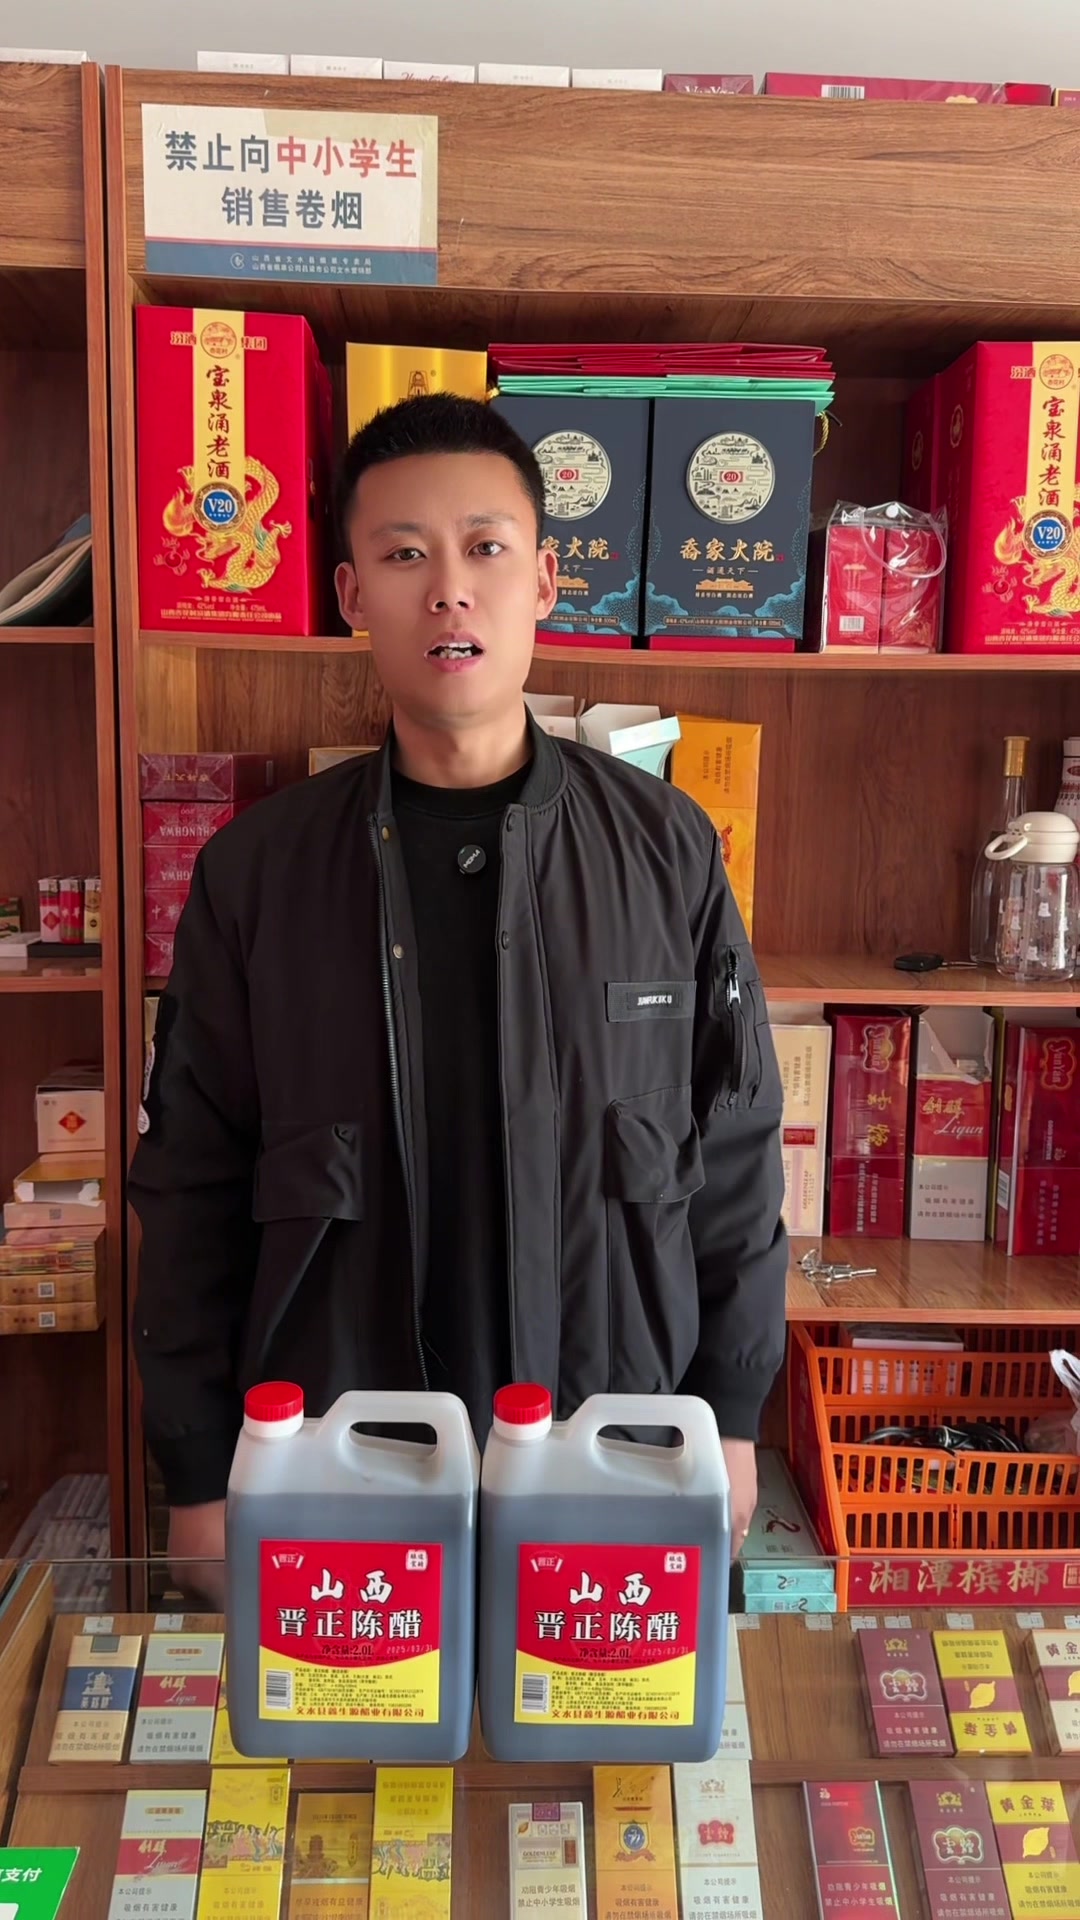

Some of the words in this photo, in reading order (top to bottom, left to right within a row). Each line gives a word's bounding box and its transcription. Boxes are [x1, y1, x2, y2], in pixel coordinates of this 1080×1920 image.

[165, 131, 417, 179] 禁止向中小学生
[221, 187, 363, 230] 销售卷烟
[206, 365, 233, 480] 宝泉涌老酒
[1038, 395, 1066, 508] 宝泉涌老酒
[561, 470, 574, 480] 20
[725, 472, 738, 482] 20
[207, 498, 233, 513] V20
[1036, 526, 1061, 540] V20
[557, 565, 581, 573] 天下
[934, 1117, 984, 1138] Liqun
[311, 1568, 393, 1604] 山西
[570, 1571, 652, 1606] 山西
[869, 1560, 1049, 1596] 湘潭槟榔
[277, 1608, 422, 1639] 晋正陈醋
[534, 1612, 680, 1642] 晋正陈醋
[0, 1867, 42, 1882] 支付
